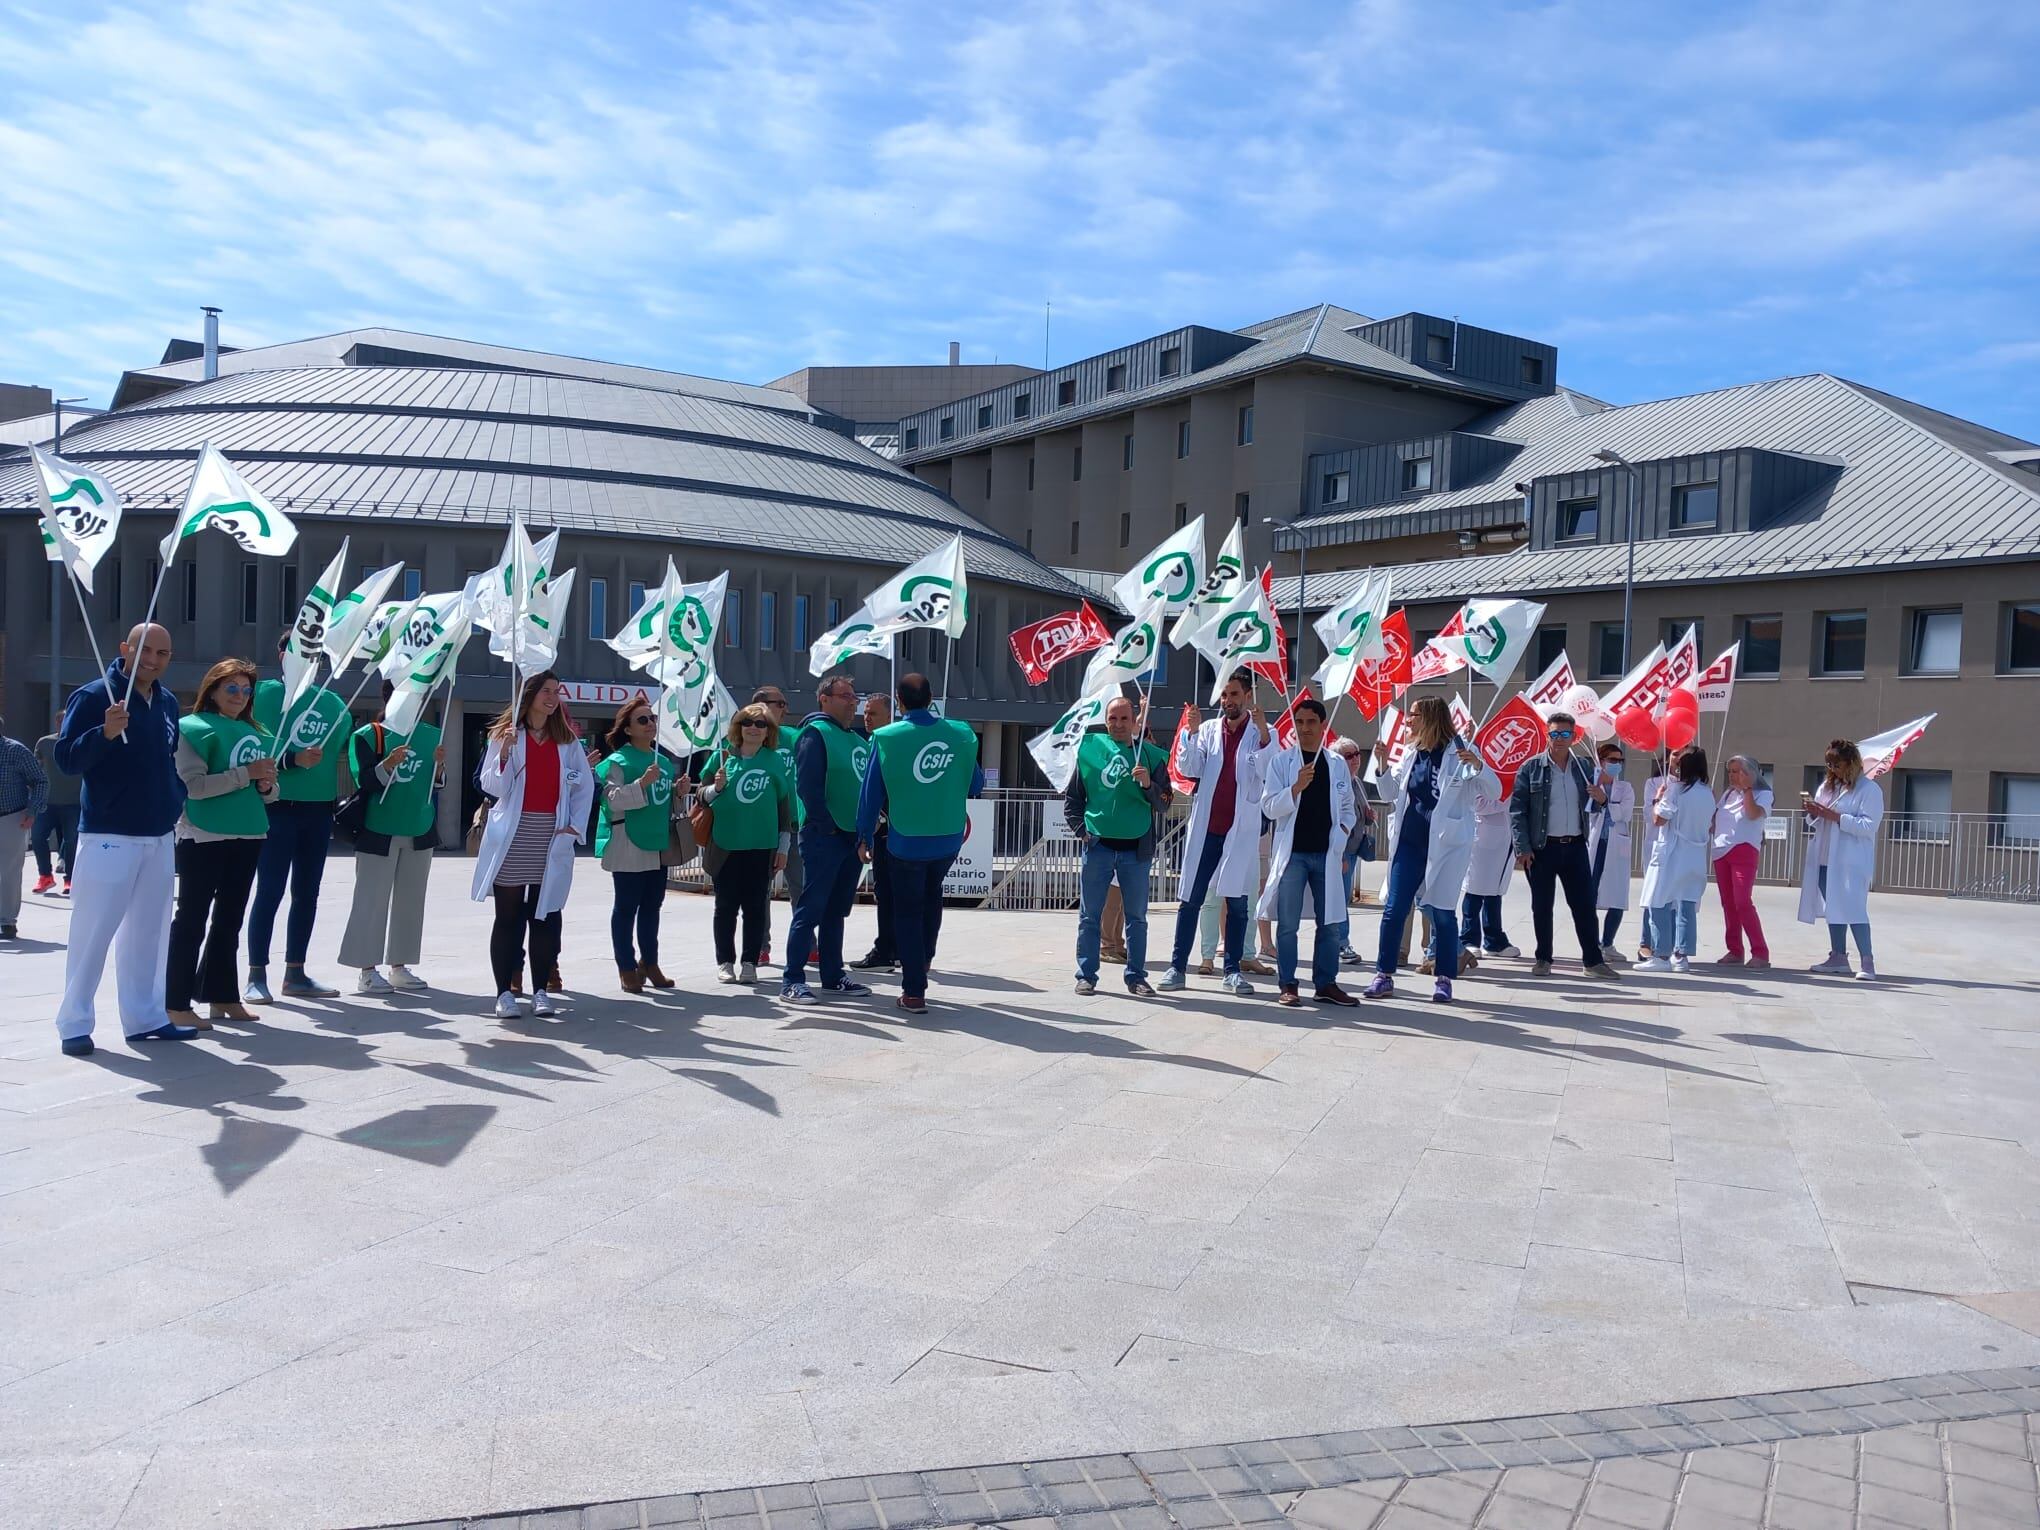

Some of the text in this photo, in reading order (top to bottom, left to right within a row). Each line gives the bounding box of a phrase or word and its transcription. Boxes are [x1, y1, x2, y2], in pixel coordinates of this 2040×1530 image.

[558, 684, 650, 703] ALIDA
[301, 720, 329, 736] CSIF
[1485, 720, 1527, 762] UGT
[921, 753, 955, 770] CSIF
[743, 776, 770, 792] CSIF
[958, 885, 989, 895] FUMAR
